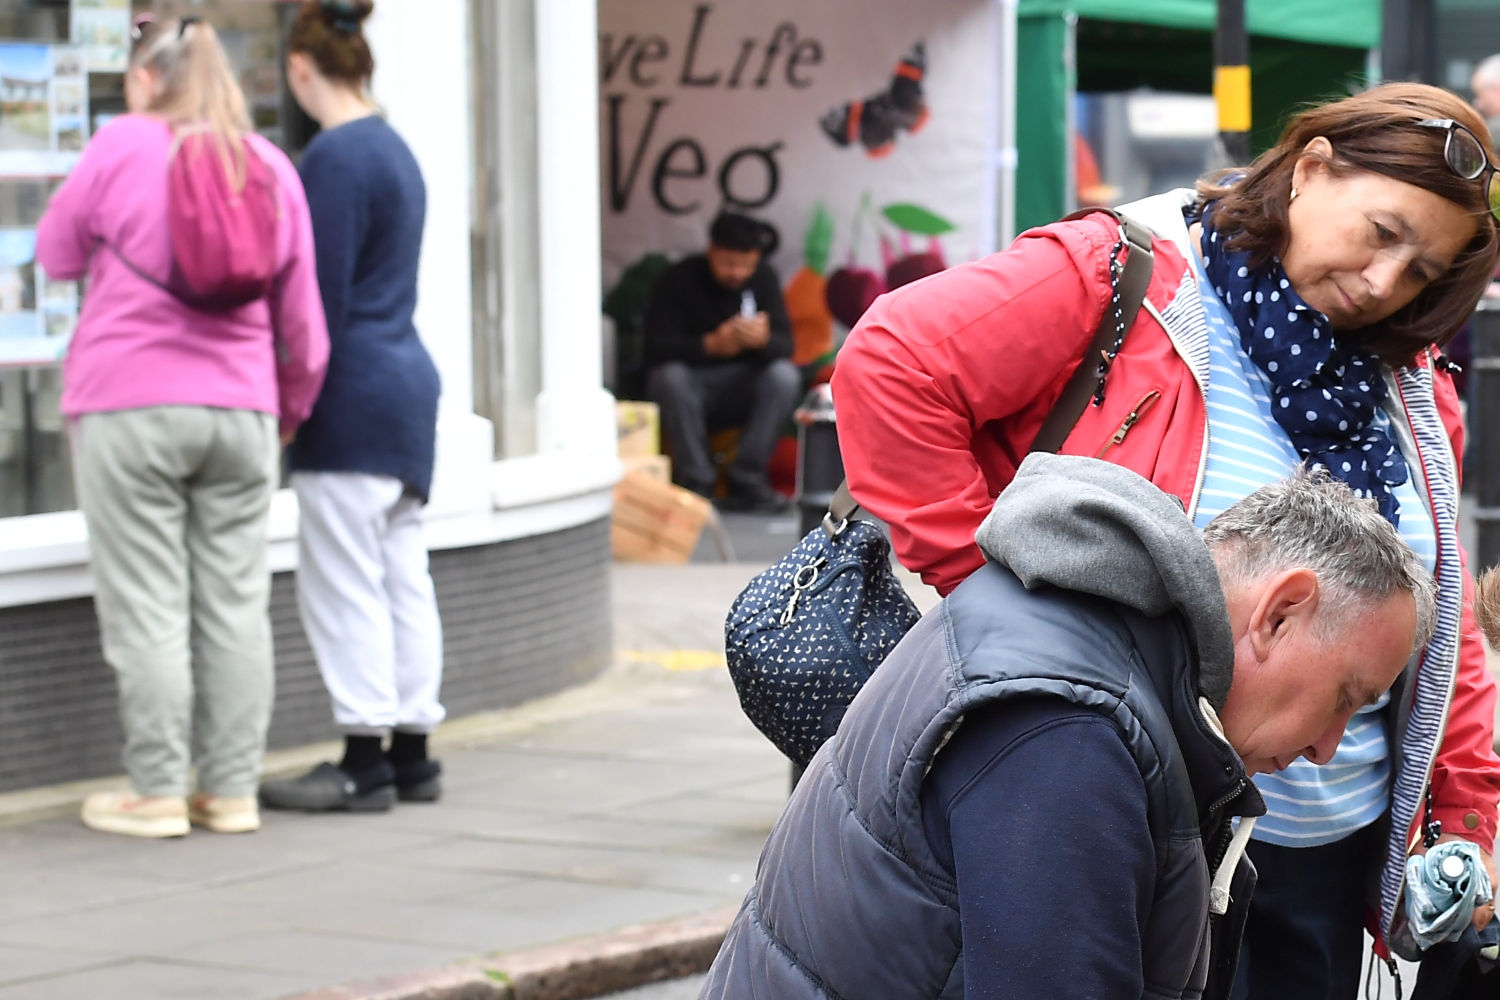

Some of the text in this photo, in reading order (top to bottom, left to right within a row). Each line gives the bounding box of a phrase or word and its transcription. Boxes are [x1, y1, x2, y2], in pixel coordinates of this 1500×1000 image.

[600, 4, 823, 89] ve Life
[604, 94, 787, 255] Veg
